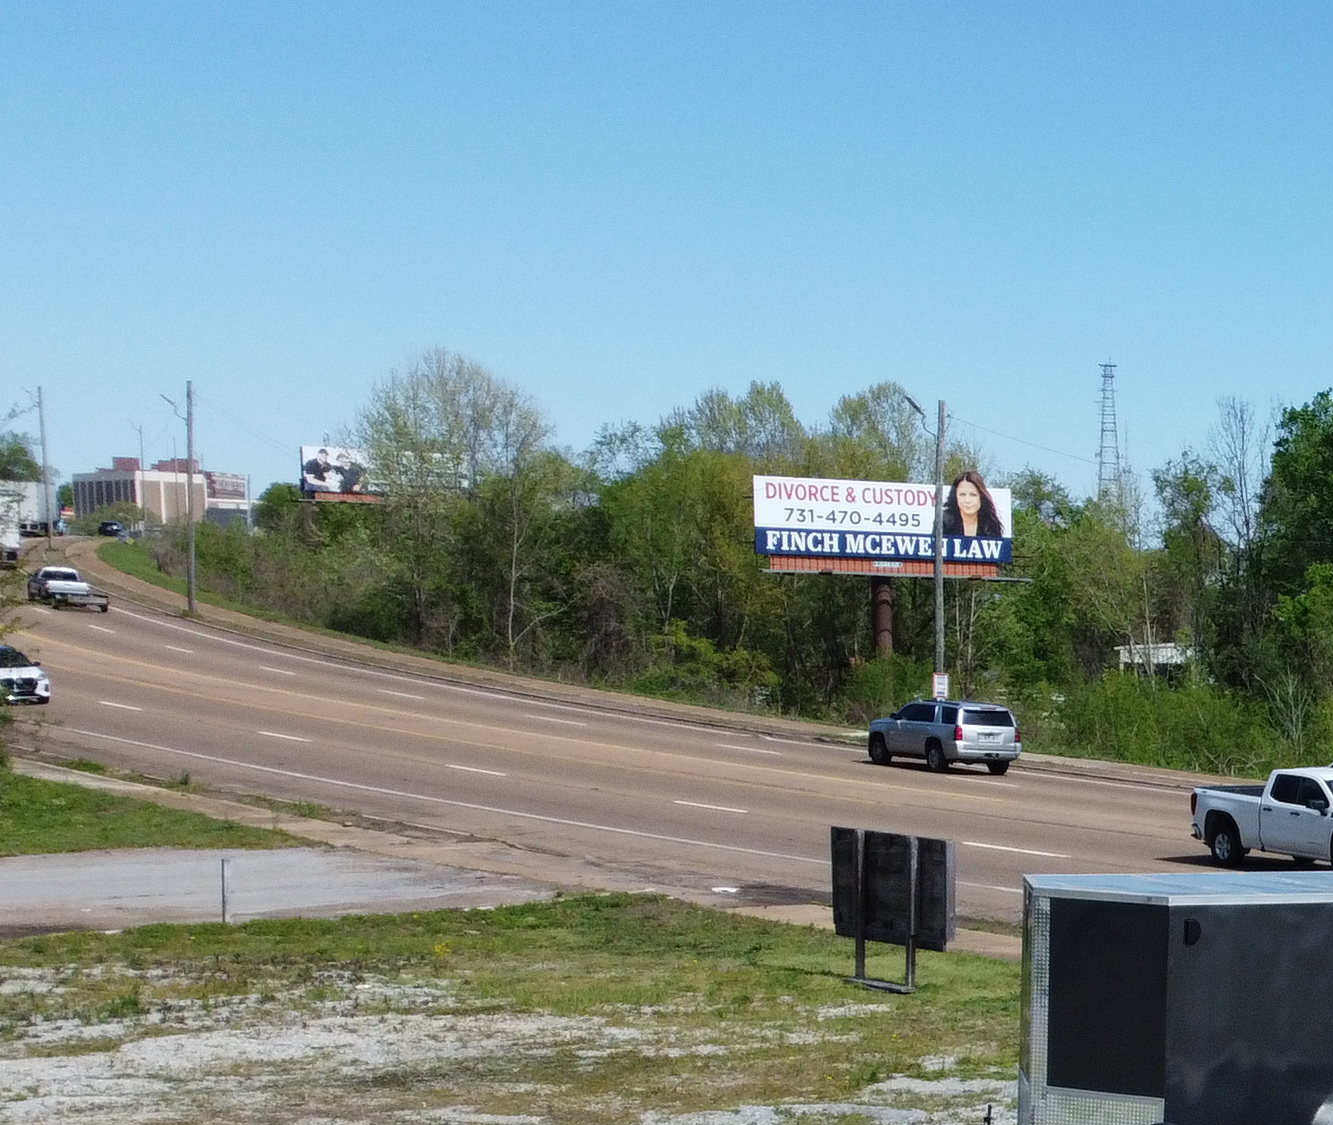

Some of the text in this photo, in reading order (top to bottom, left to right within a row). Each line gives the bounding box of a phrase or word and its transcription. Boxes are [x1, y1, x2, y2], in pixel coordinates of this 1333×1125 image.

[765, 482, 937, 507] DIVORCE & CUSTODY
[784, 507, 921, 528] 731-470-4495
[765, 530, 840, 553] FINCH
[953, 538, 1003, 559] LAW
